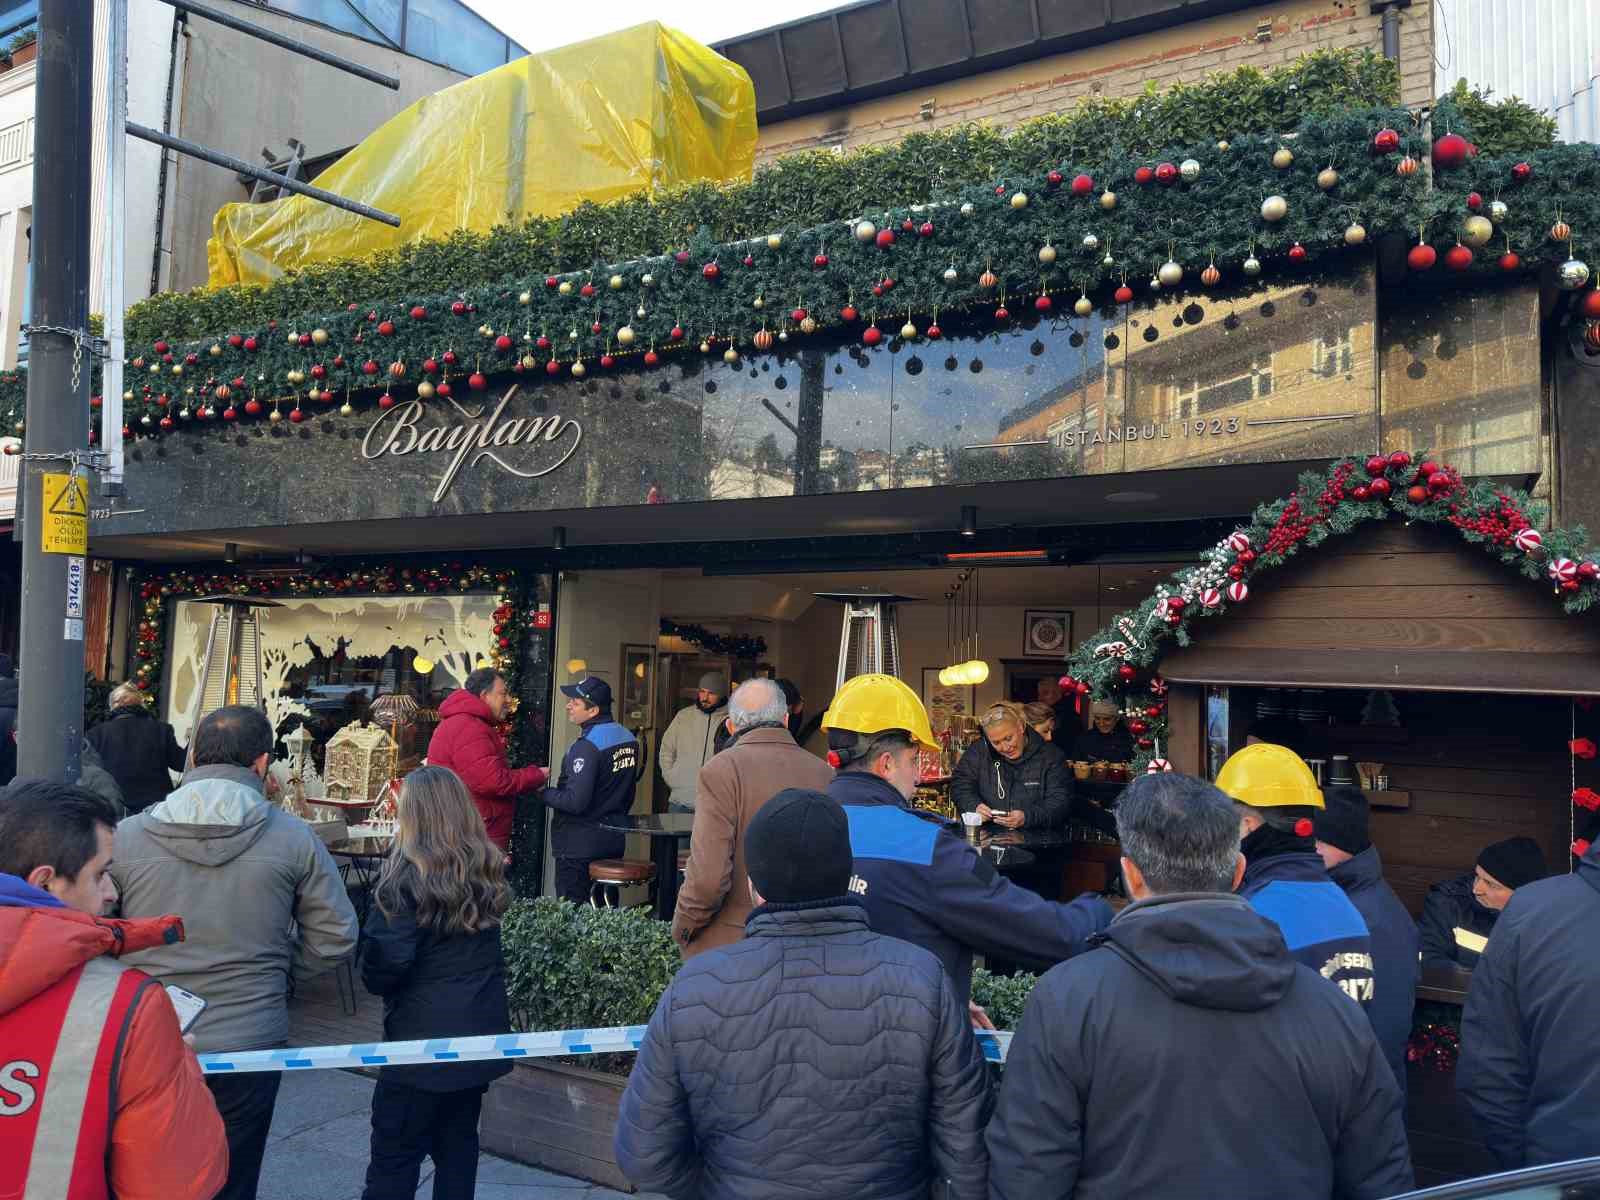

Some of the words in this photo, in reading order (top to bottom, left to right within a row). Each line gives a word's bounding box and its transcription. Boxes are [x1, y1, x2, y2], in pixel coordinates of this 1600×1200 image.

[362, 384, 582, 503] Baylan
[1182, 415, 1241, 437] 1923
[69, 565, 81, 609] 314418
